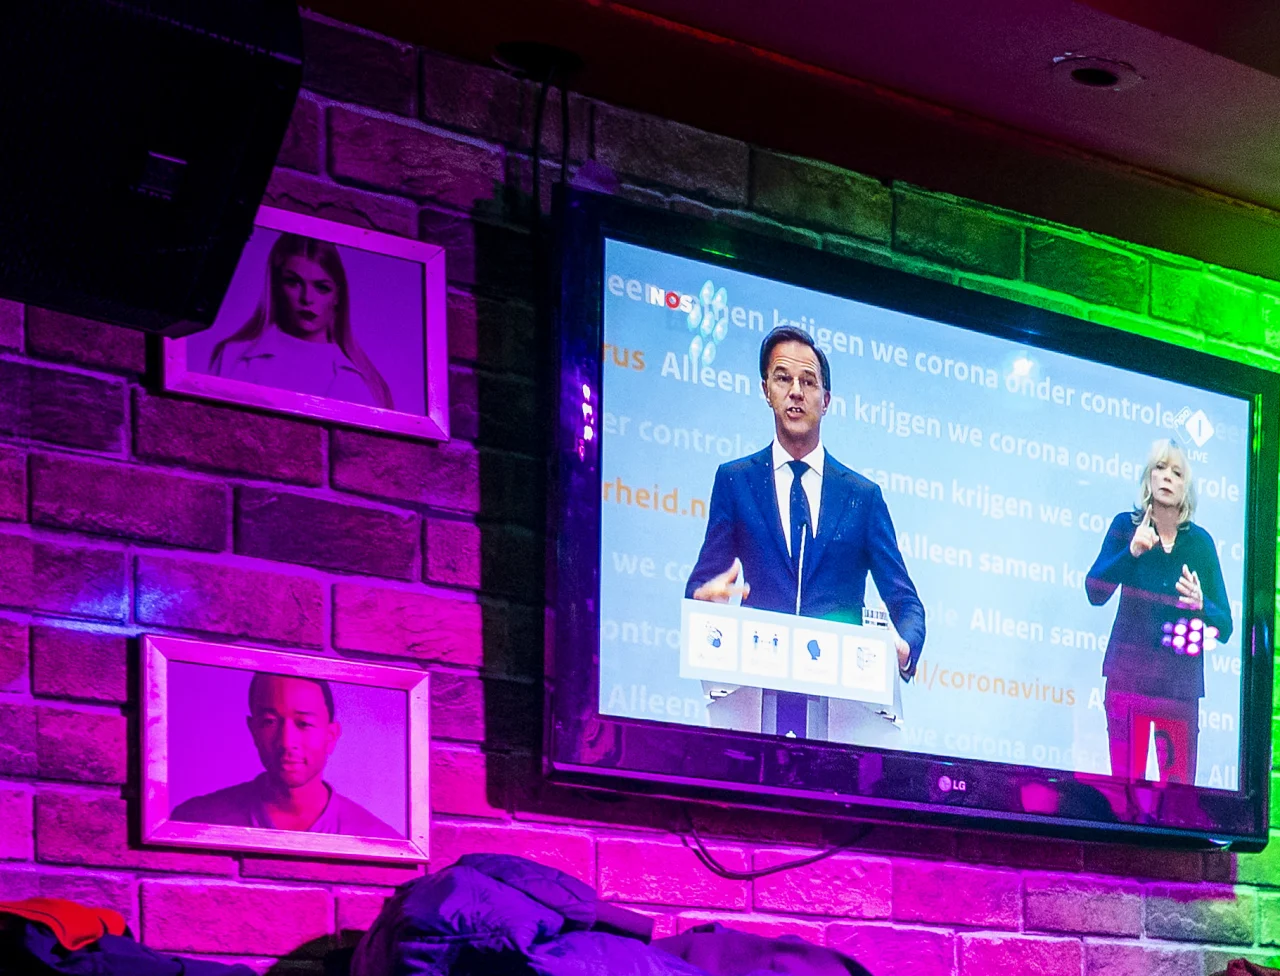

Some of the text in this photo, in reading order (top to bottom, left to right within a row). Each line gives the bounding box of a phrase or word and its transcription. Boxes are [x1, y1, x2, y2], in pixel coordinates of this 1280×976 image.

[650, 287, 692, 313] NOS
[871, 341, 908, 368] we
[915, 352, 998, 389] corona
[1006, 374, 1075, 407] onder
[1081, 390, 1175, 429] controle
[661, 352, 750, 395] Alleen
[855, 394, 941, 440] krijgen
[948, 417, 983, 446] we
[989, 434, 1070, 467] corona
[1076, 449, 1141, 482] onder
[1197, 473, 1239, 502] role
[1188, 449, 1209, 464] LIVE
[602, 478, 706, 518] rheid.n
[896, 531, 973, 569] Alleen
[979, 553, 1056, 584] samen
[862, 468, 944, 502] samen
[952, 480, 1033, 519] krijgen
[1040, 499, 1072, 528] we
[612, 552, 656, 577] we
[970, 608, 1044, 641] Alleen
[1212, 653, 1240, 675] we
[601, 621, 680, 649] ontro
[913, 660, 1076, 706] l/coronavirus
[608, 684, 699, 720] Alleen
[944, 729, 1025, 759] corona
[953, 779, 966, 791] LG
